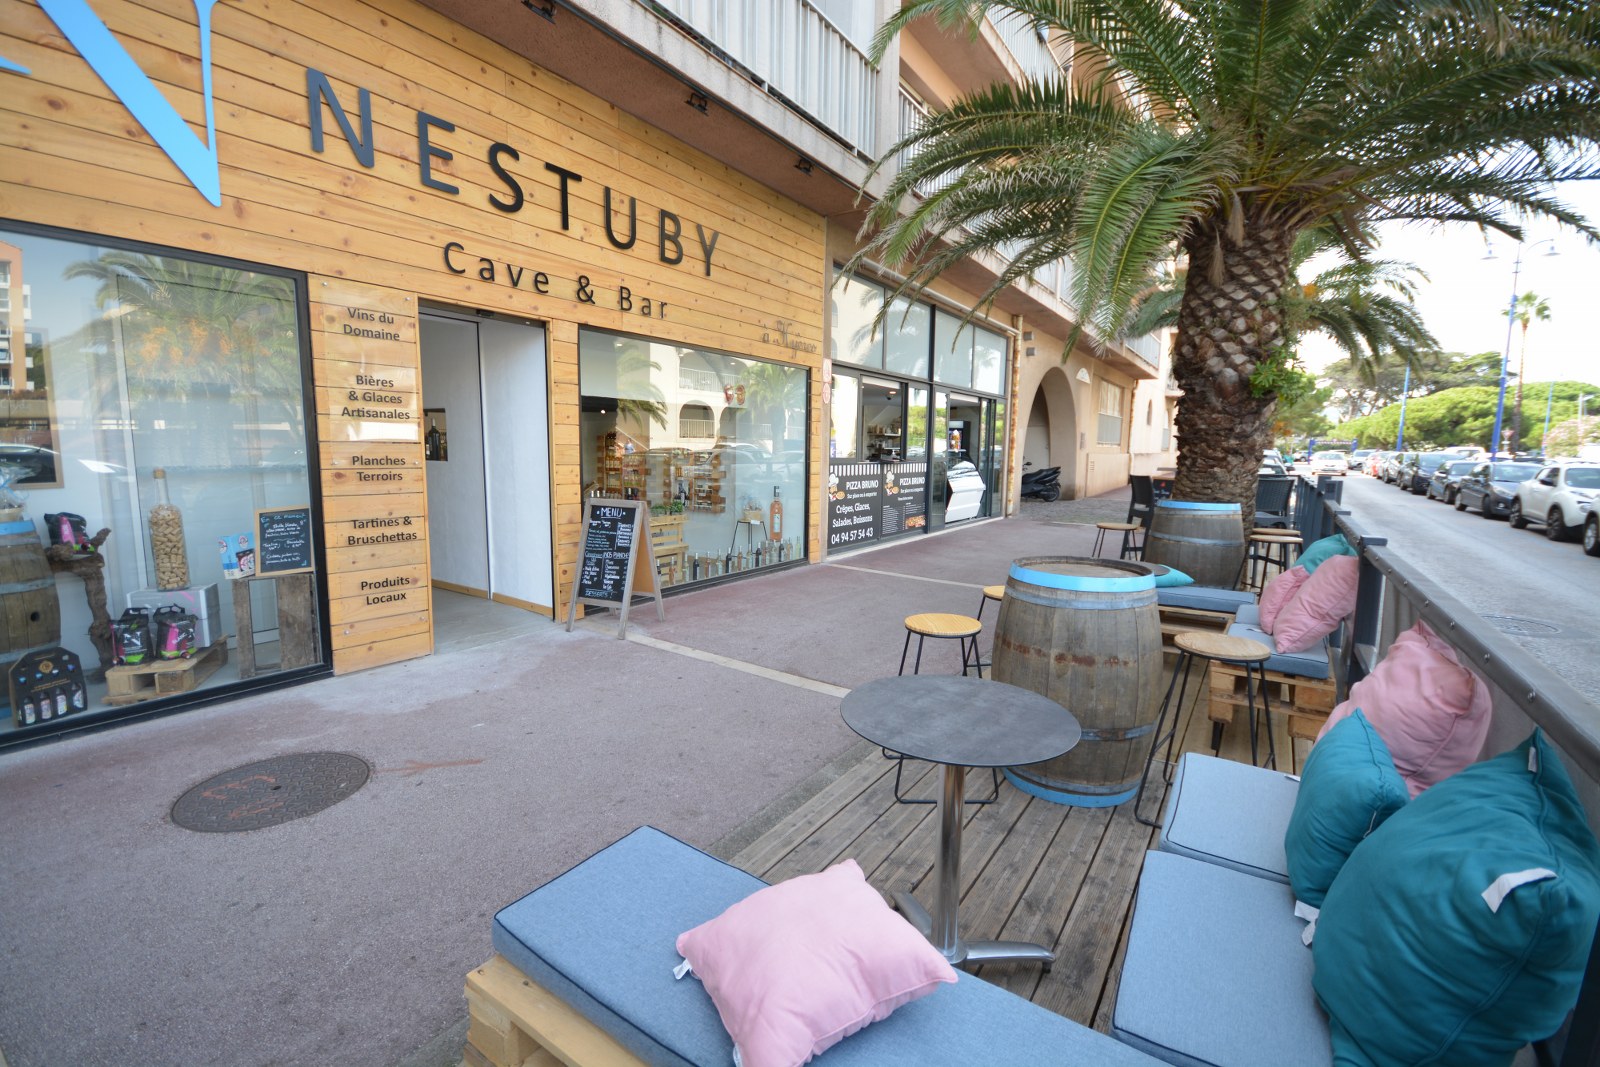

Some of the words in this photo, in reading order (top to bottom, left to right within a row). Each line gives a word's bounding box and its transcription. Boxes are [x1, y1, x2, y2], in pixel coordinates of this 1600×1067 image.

[306, 67, 720, 277] NESTUBY
[444, 241, 550, 294] Cave
[576, 275, 596, 304] &
[619, 286, 668, 319] Bar
[347, 307, 375, 322] Vins
[379, 313, 394, 324] du
[343, 324, 400, 341] Domaine
[356, 375, 394, 388] Bières
[348, 390, 358, 401] &
[362, 392, 403, 404] Glaces
[341, 406, 410, 420] Artisanales
[352, 455, 406, 466] Planches
[356, 471, 403, 482] Terroirs
[900, 478, 912, 486] PIZZA
[912, 476, 925, 485] BRUNO
[846, 481, 862, 490] PIZZA
[862, 480, 879, 489] BRUNO
[600, 507, 622, 516] MENU
[836, 504, 854, 514] Crêpes,
[854, 502, 870, 511] Glaces,
[352, 518, 400, 529] Tartines
[403, 516, 412, 526] &
[832, 518, 852, 528] Salades,
[348, 531, 418, 546] Bruschettas
[831, 533, 840, 545] 04
[841, 531, 849, 543] 94
[849, 530, 857, 541] 57
[858, 528, 865, 540] 54
[866, 527, 874, 538] 43
[360, 576, 410, 591] Produits
[366, 592, 407, 606] Locaux
